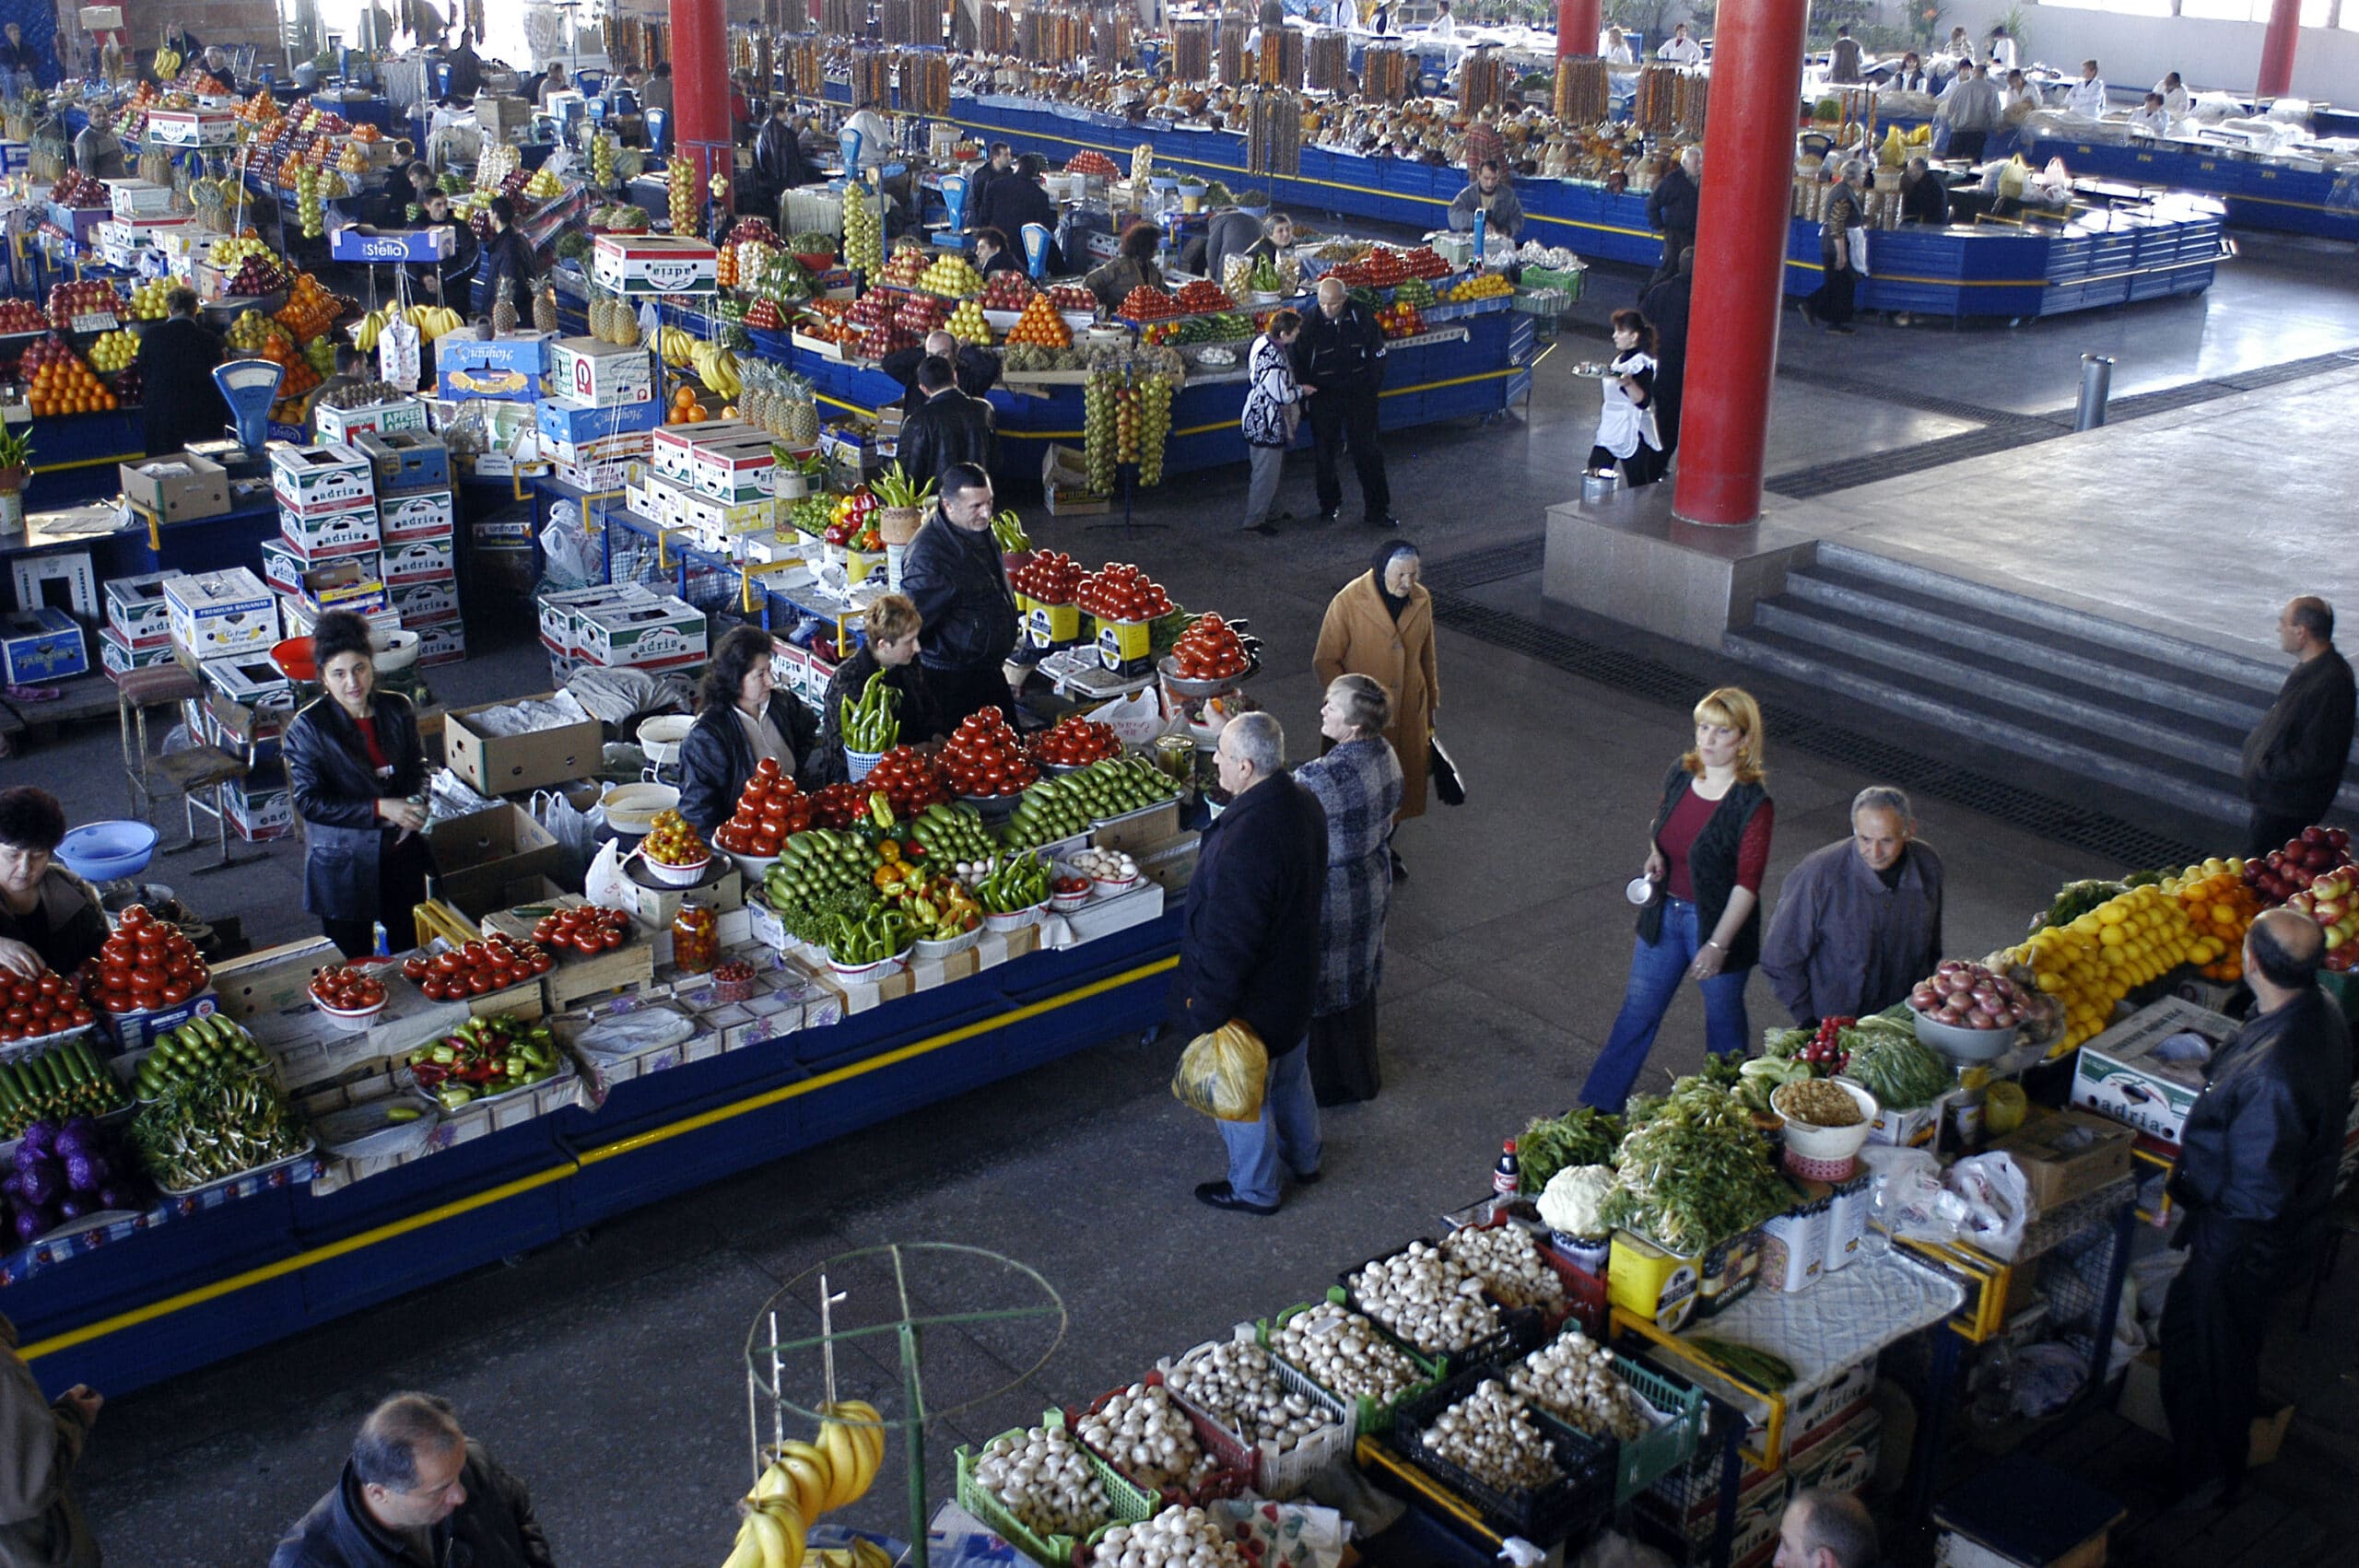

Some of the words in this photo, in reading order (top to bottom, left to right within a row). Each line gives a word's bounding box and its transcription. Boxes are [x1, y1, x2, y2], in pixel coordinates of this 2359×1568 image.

[367, 243, 402, 257] Stella
[653, 266, 691, 277] adria
[387, 409, 421, 424] APPLES
[320, 487, 355, 501] adria
[402, 514, 436, 527] adria
[324, 531, 361, 544] adria
[402, 559, 437, 571] adria
[200, 606, 233, 617] PREMIUM
[236, 600, 268, 613] BANANAS
[409, 601, 443, 613] adria
[639, 638, 679, 653] adria
[2101, 1099, 2160, 1131] adria
[1815, 1384, 1866, 1419] adria
